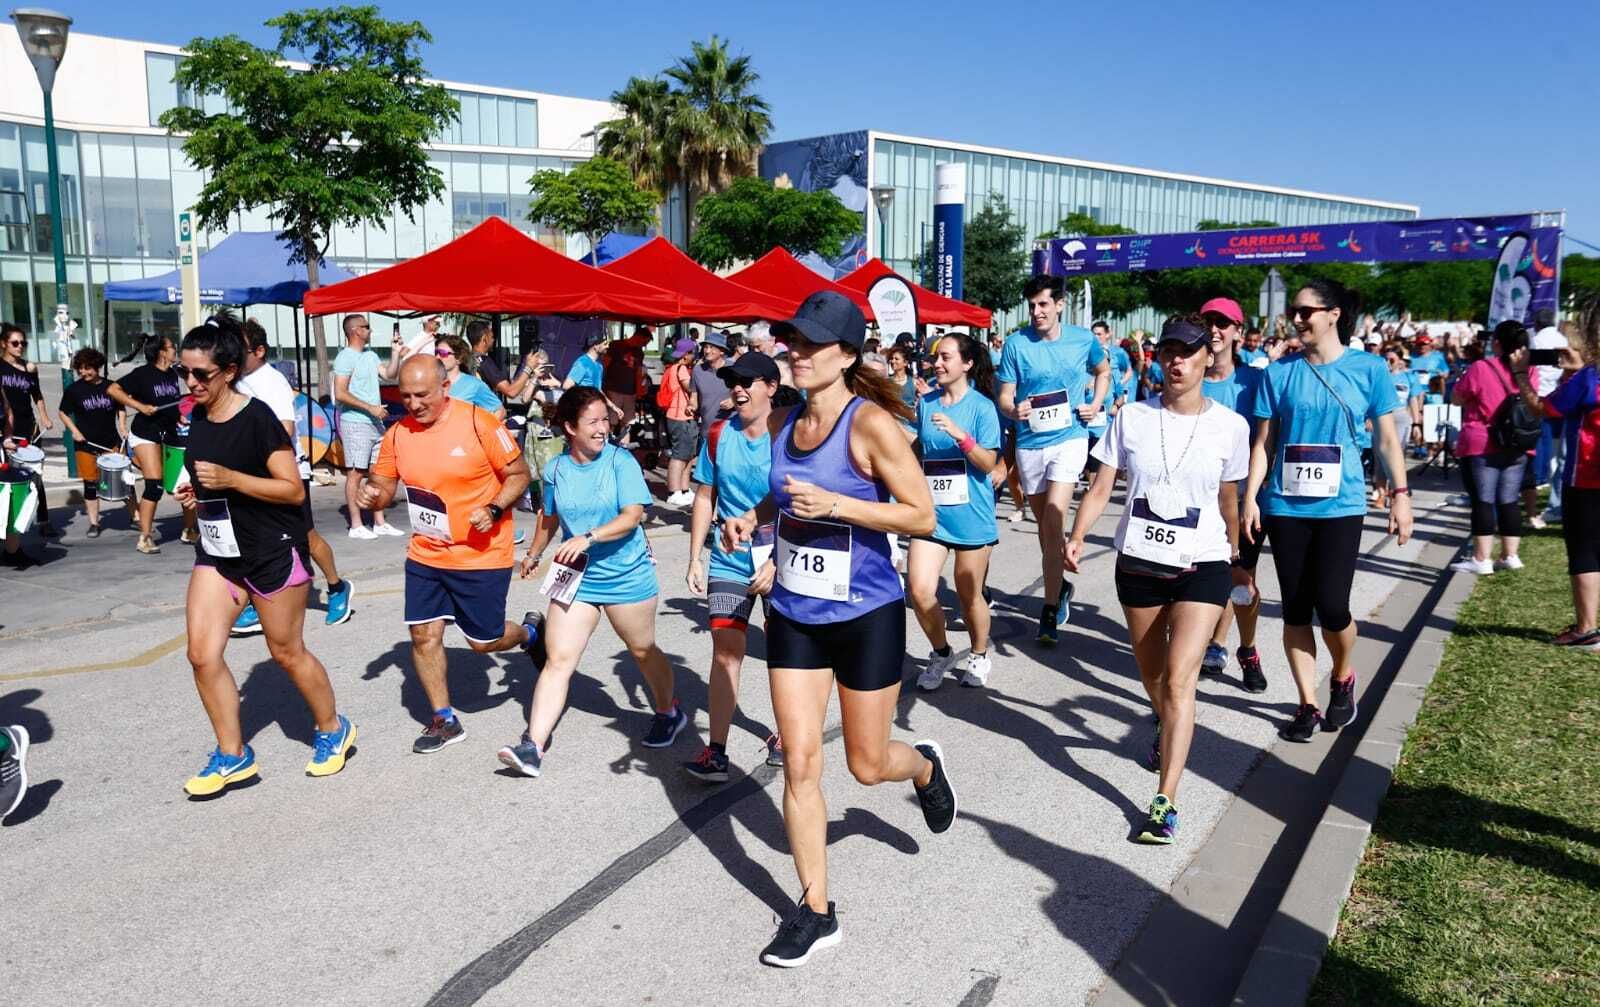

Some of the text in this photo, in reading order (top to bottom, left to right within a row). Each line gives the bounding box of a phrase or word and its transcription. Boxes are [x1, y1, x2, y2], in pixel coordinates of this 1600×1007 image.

[1229, 231, 1320, 247] CARRERA 5K
[938, 254, 944, 264] DE
[945, 254, 953, 278] SALUD
[945, 279, 952, 288] LA
[1038, 408, 1058, 420] 217
[1295, 466, 1323, 480] 716
[932, 479, 953, 491] 287
[419, 511, 438, 527] 437
[1144, 524, 1177, 545] 565
[789, 550, 825, 573] 718
